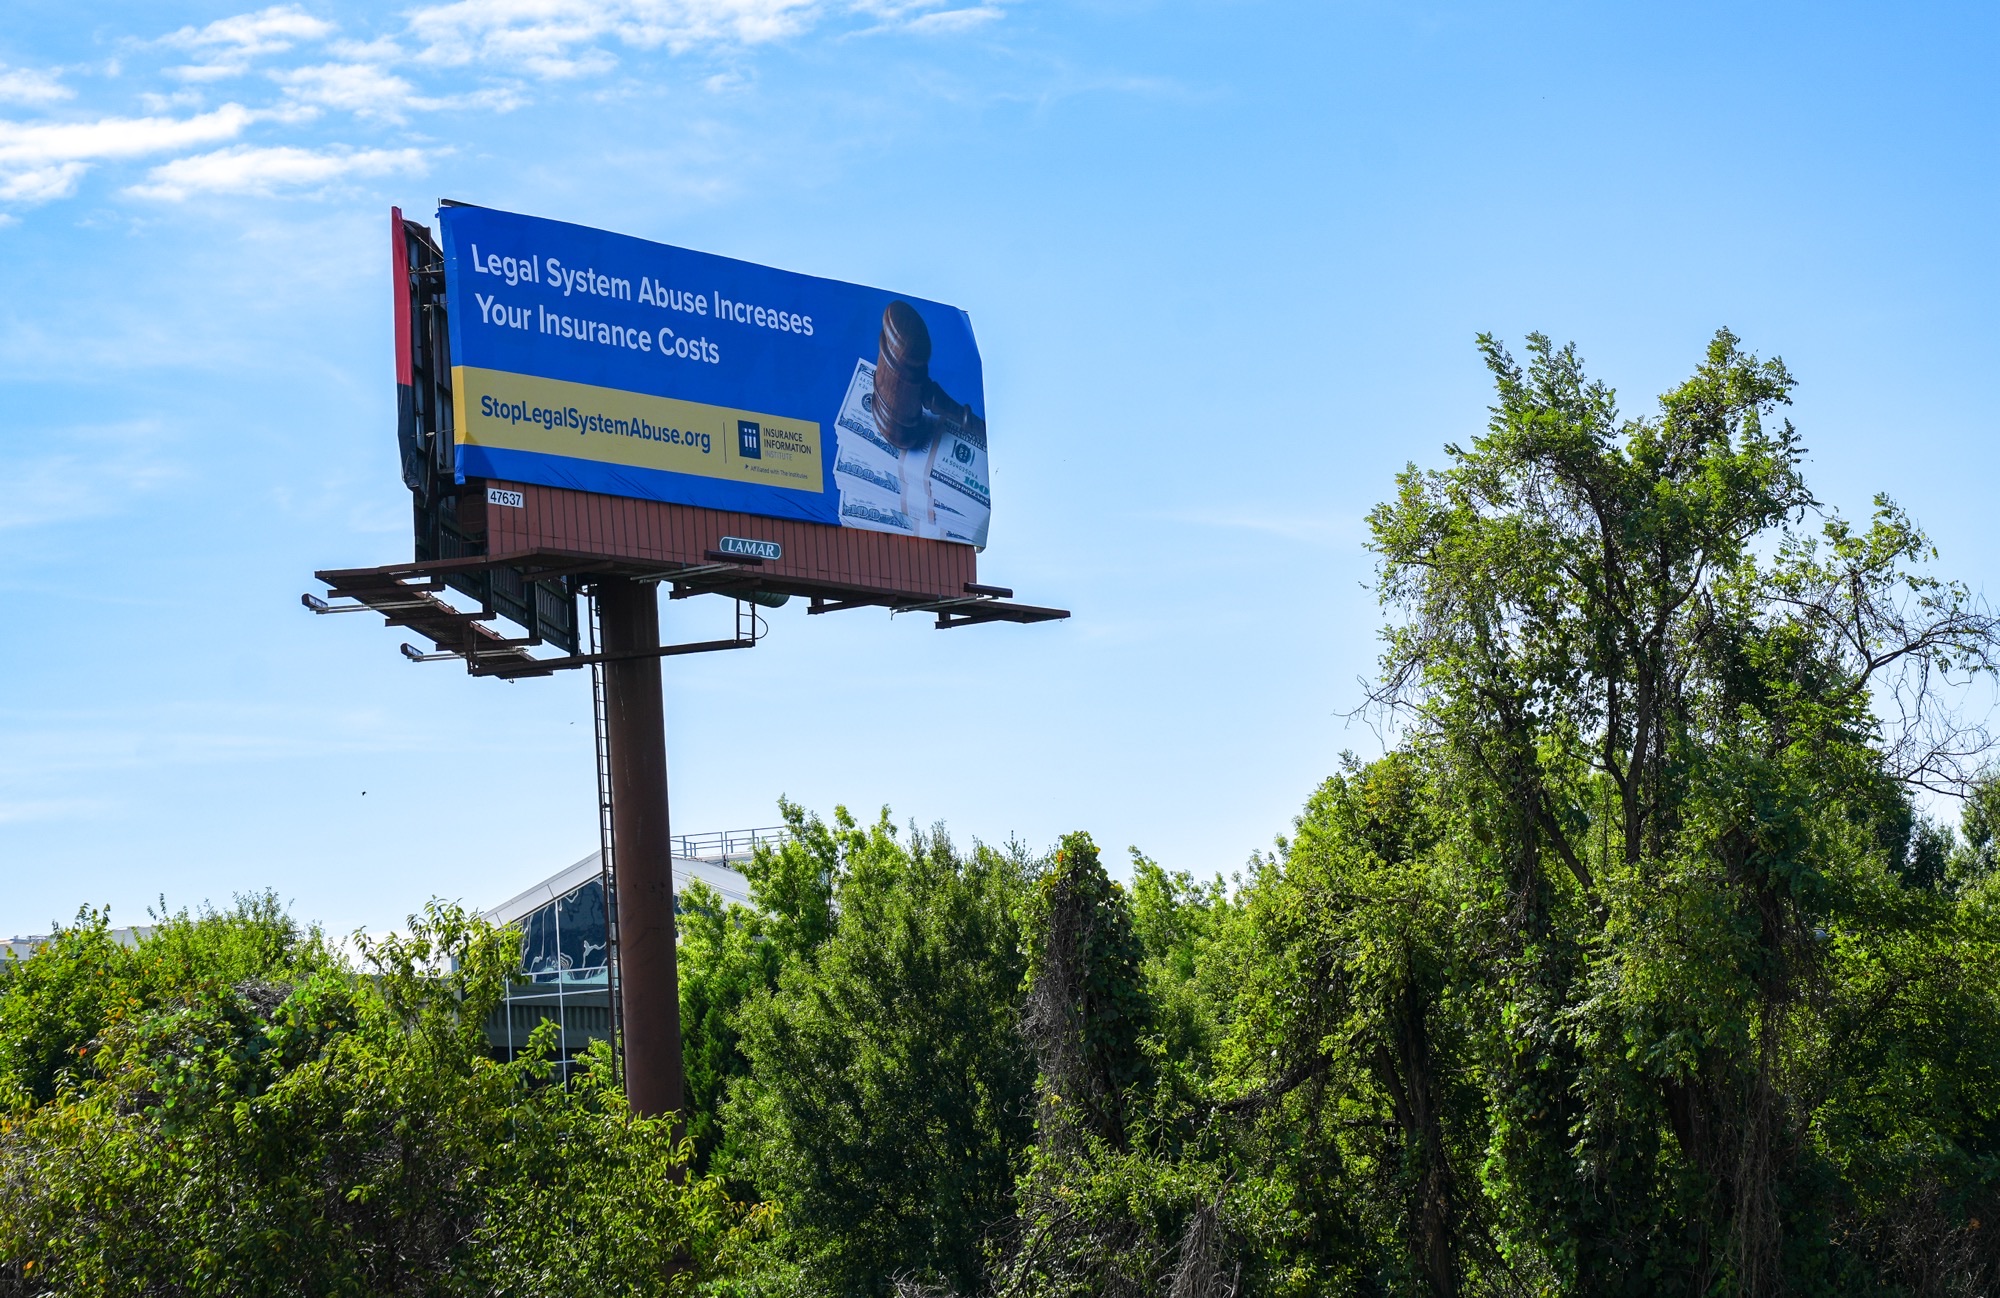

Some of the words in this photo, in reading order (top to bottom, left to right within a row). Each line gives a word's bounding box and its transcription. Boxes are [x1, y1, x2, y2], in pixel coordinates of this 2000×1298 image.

[471, 243, 540, 287] Legal
[546, 257, 631, 301] System
[638, 276, 708, 316] Abuse
[714, 290, 814, 337] Increases
[474, 292, 532, 331] Your
[538, 304, 652, 352] Insurance
[658, 327, 720, 364] Costs
[481, 395, 711, 454] StopLegalSystemAbuse.org
[763, 427, 803, 443] INSURANCE
[763, 438, 812, 455] INFORMATION
[764, 450, 793, 461] INSTITUTE
[750, 465, 770, 474] Affiliated
[780, 469, 789, 477] The
[963, 475, 990, 496] 100
[490, 491, 521, 506] 47637
[728, 540, 775, 556] LAMAR
